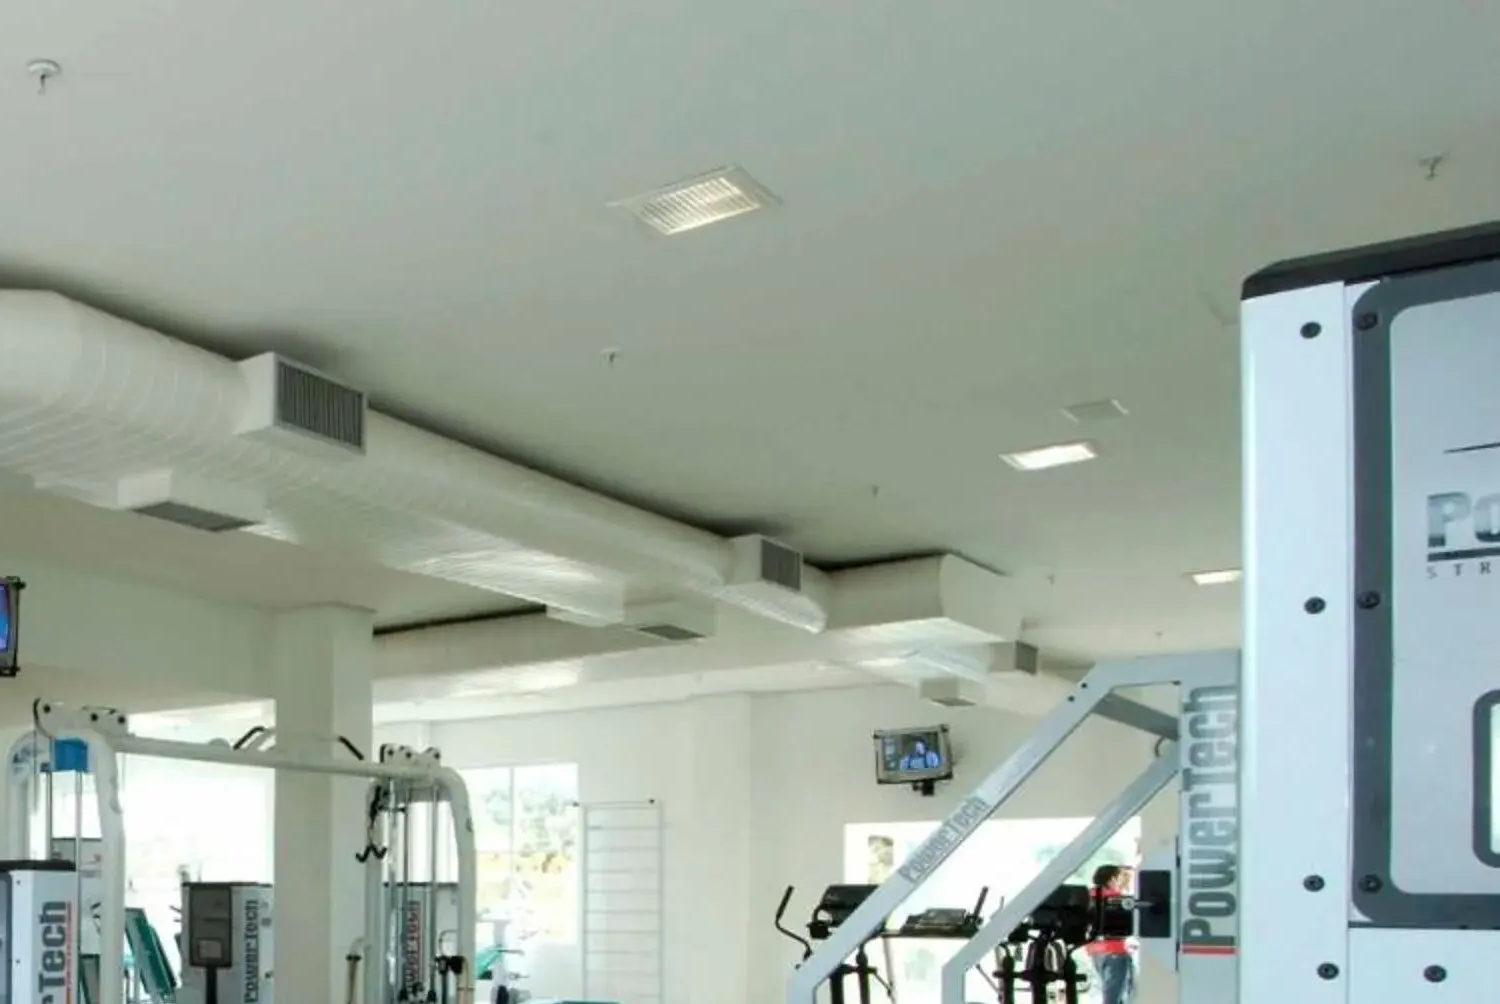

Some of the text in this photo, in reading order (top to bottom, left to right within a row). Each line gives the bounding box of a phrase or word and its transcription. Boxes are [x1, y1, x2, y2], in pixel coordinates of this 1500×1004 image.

[897, 797, 990, 883] PowerTech
[1183, 685, 1237, 945] PowerTech
[243, 900, 258, 1003] PowerTech
